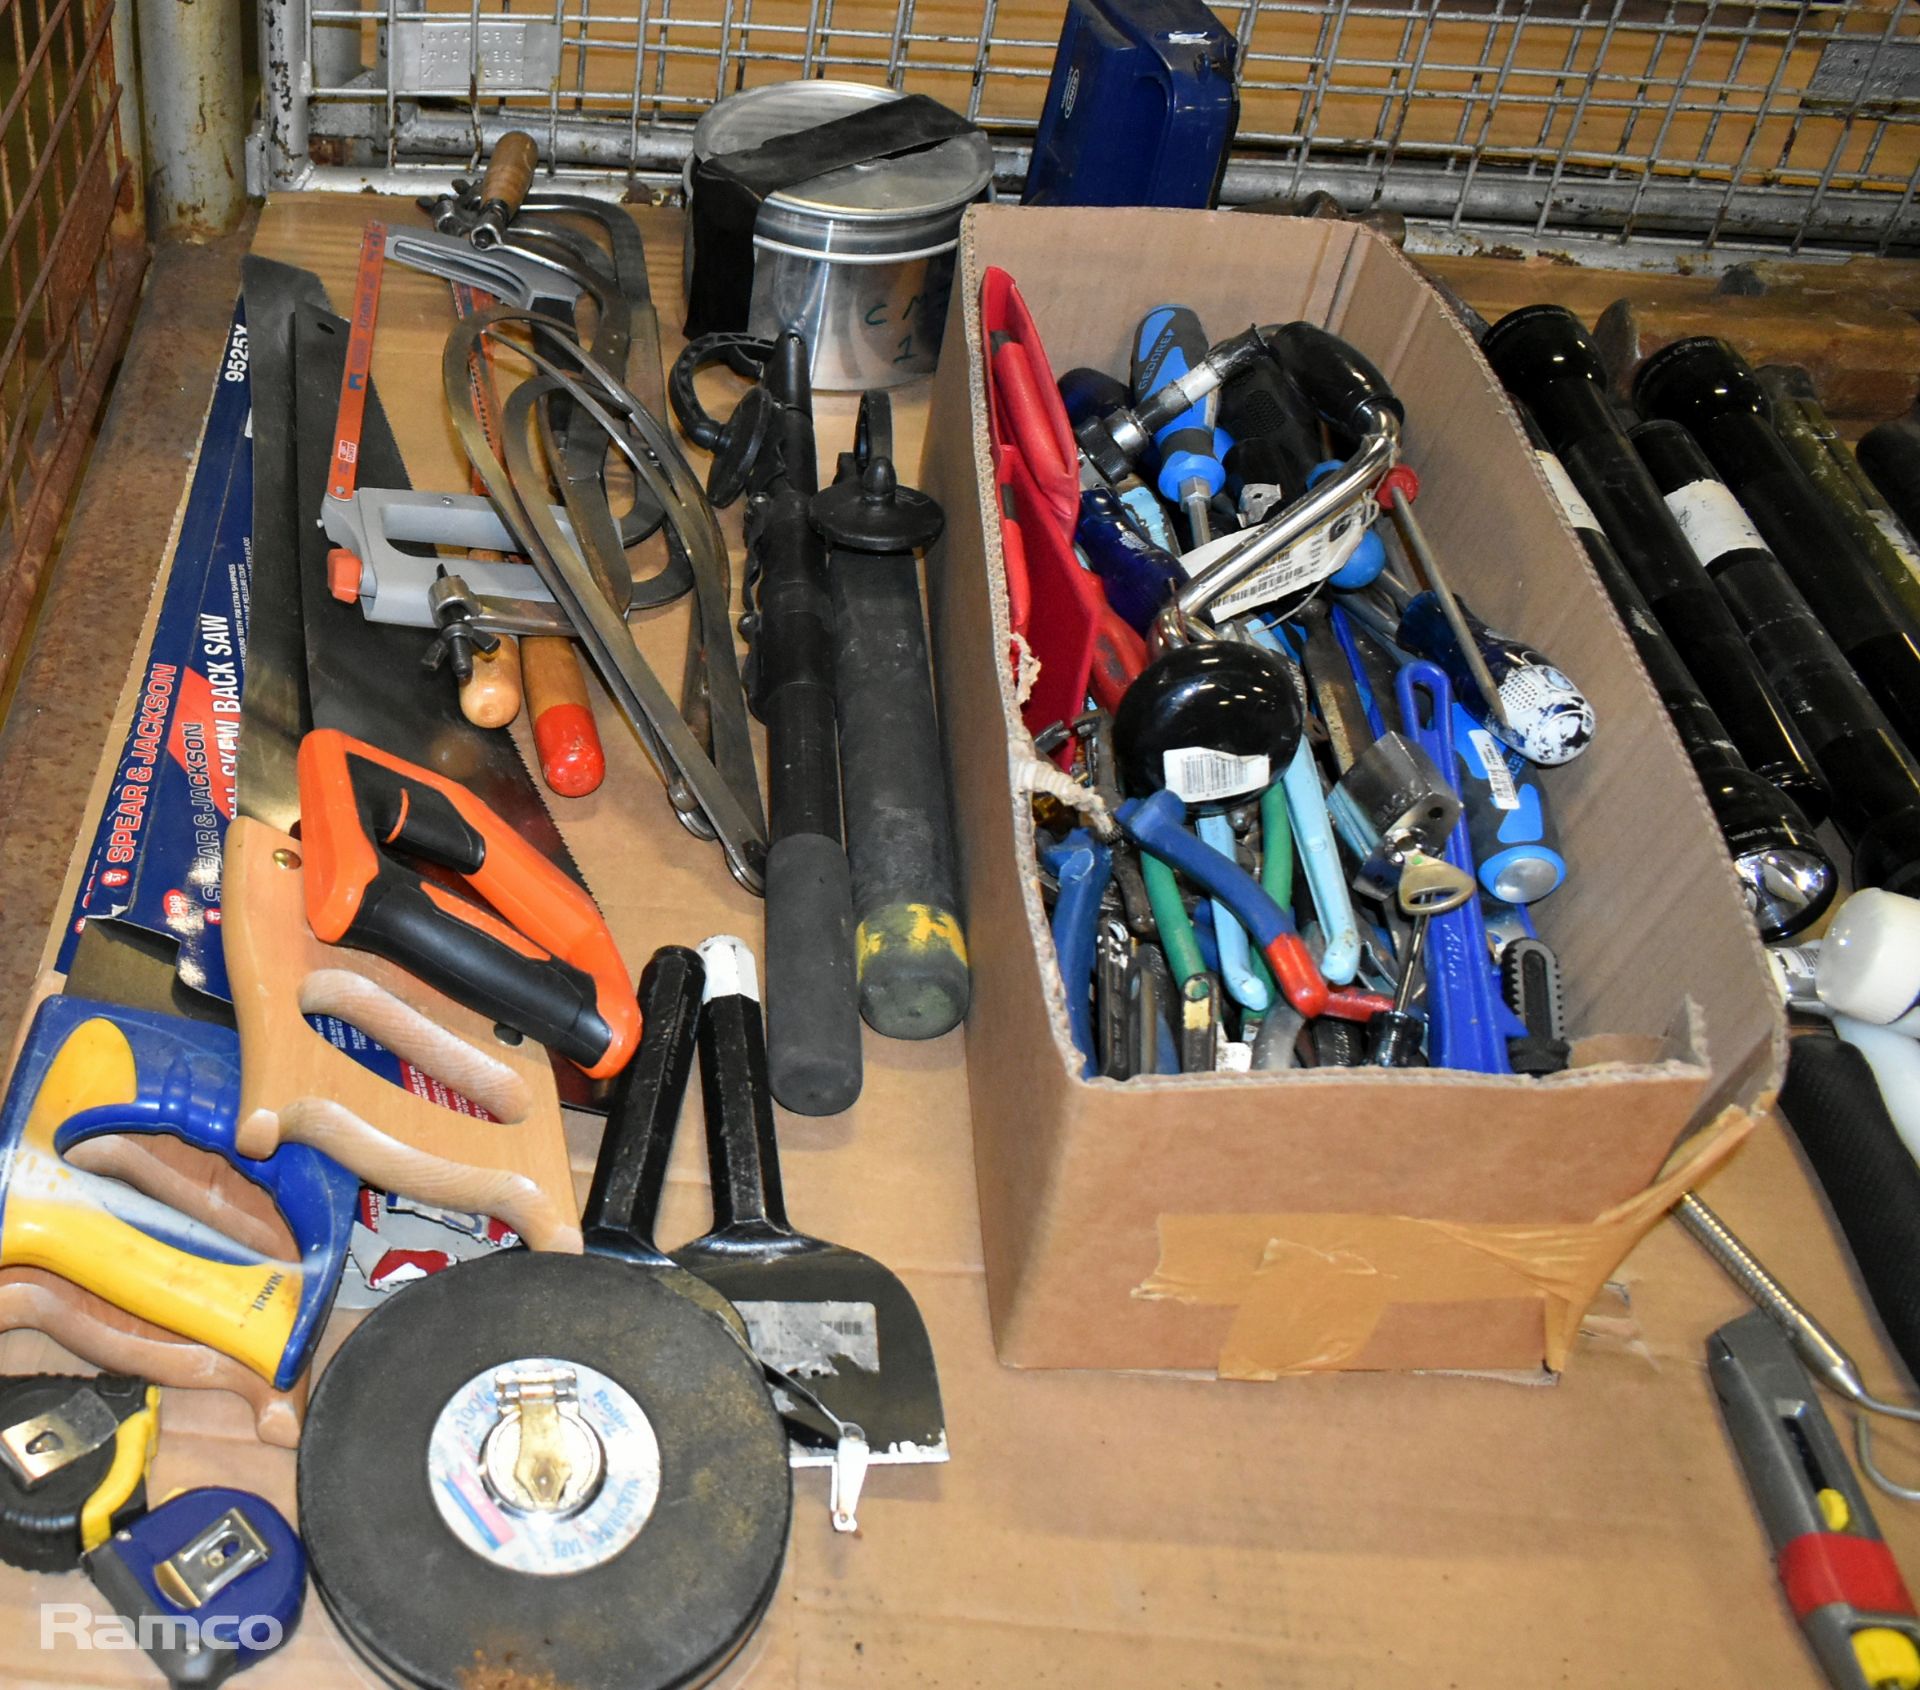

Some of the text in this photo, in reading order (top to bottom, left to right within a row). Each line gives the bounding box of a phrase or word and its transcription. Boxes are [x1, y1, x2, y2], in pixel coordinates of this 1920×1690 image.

[1138, 335, 1172, 390] GEDORE
[228, 564, 239, 591] SHARPNESS
[238, 563, 247, 577] COUPE
[232, 592, 241, 608] EXTRA
[200, 612, 232, 656] SAW
[236, 619, 244, 636] TEETH
[207, 661, 241, 713] BACK
[107, 662, 178, 863] SPEAR & JACKSON
[181, 721, 214, 813] JACKSON
[193, 812, 218, 829] &
[251, 1271, 284, 1311] IRWIN
